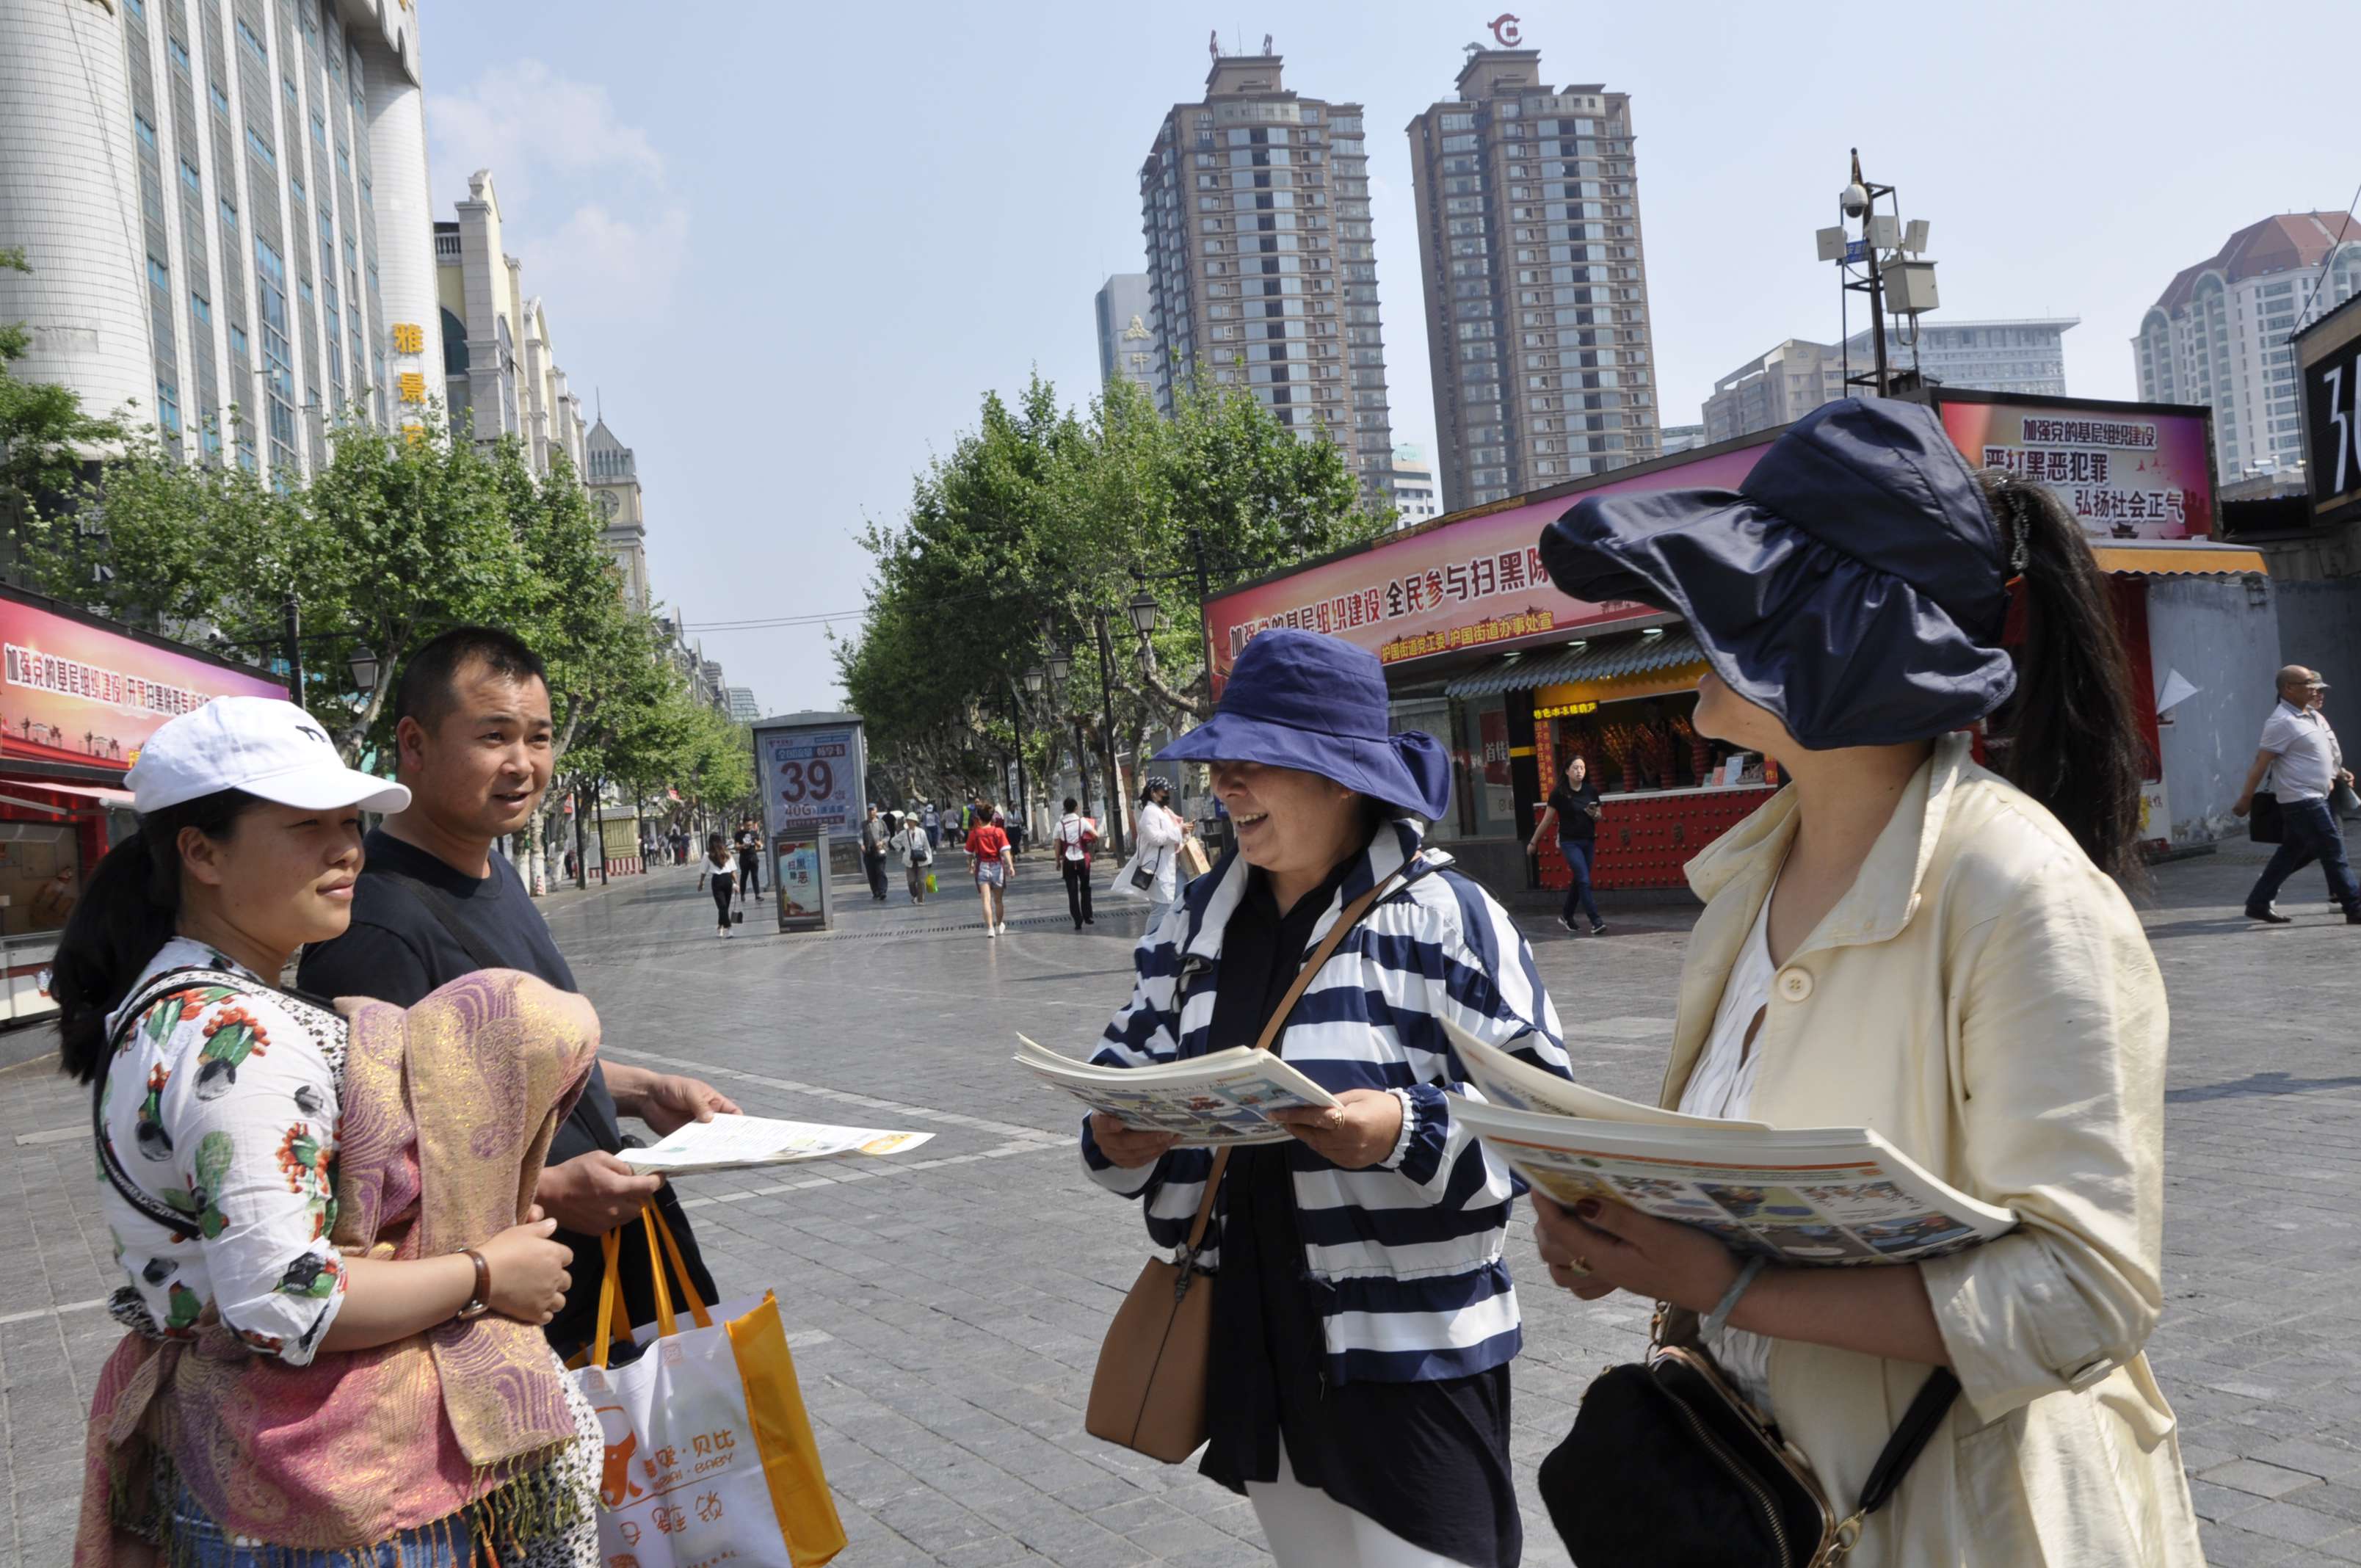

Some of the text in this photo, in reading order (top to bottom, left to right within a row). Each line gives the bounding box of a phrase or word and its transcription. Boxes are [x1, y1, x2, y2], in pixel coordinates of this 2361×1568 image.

[2023, 419, 2155, 448] 加强党的基层组织建设
[1985, 449, 2108, 482] 严打黑恶犯罪
[2075, 488, 2184, 519] 弘扬社会正气
[1381, 611, 1553, 663] 护国街道党工委 护国街道办事处宣
[6, 647, 121, 703] 加强党的基层组织建设
[780, 759, 834, 803] 39
